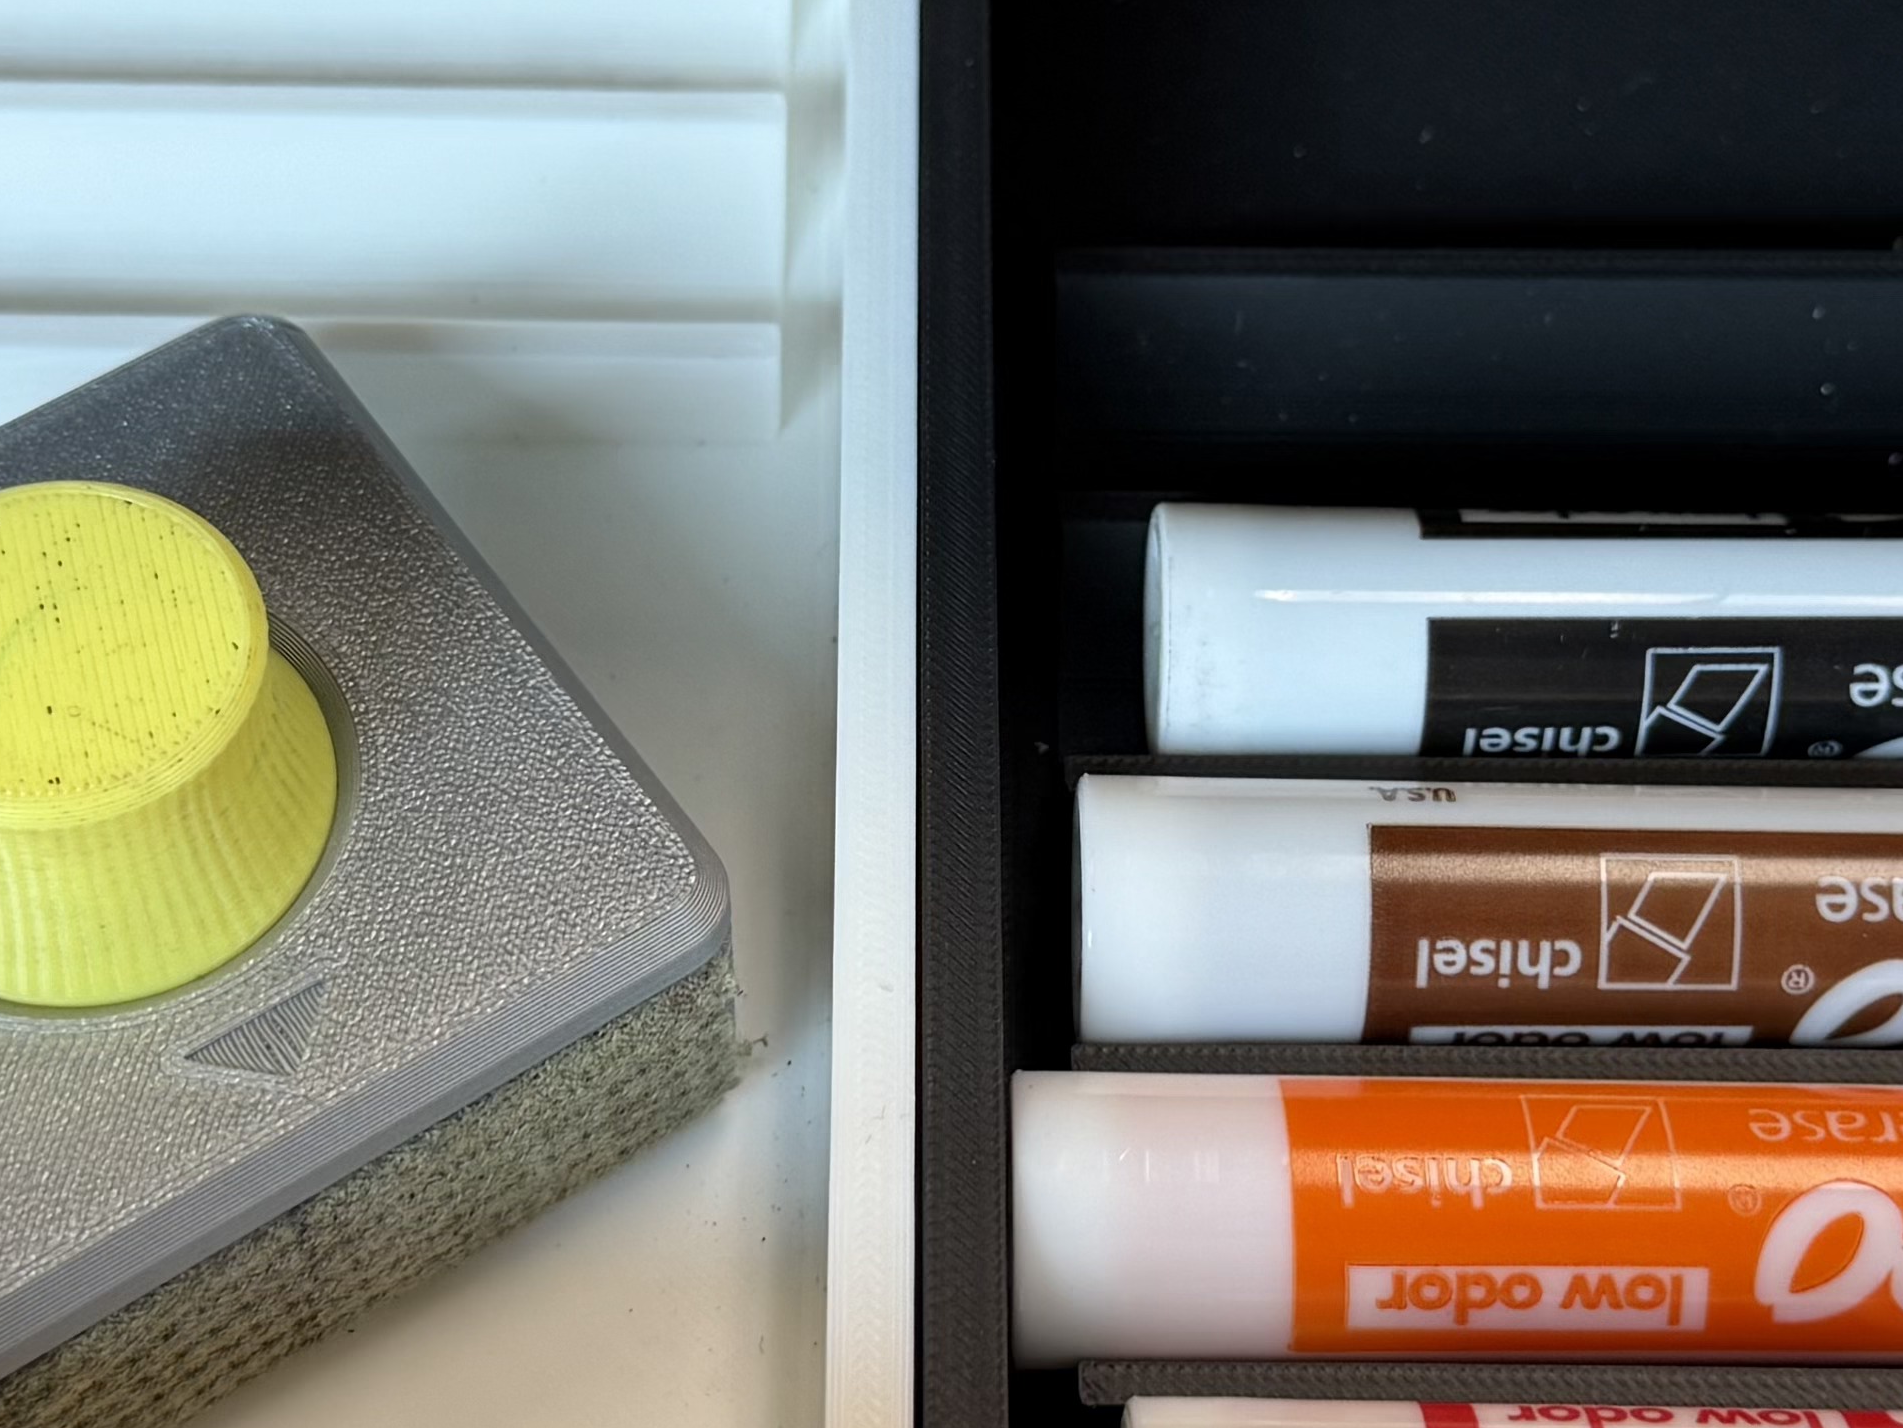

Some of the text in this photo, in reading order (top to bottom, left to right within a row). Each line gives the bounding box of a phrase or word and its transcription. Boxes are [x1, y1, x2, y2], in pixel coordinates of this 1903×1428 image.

[1461, 722, 1623, 757] chisel
[1367, 785, 1457, 803] U.S.A.
[1415, 937, 1583, 990] chisel
[1338, 1150, 1515, 1211] chisel
[1375, 1270, 1685, 1328] low odor
